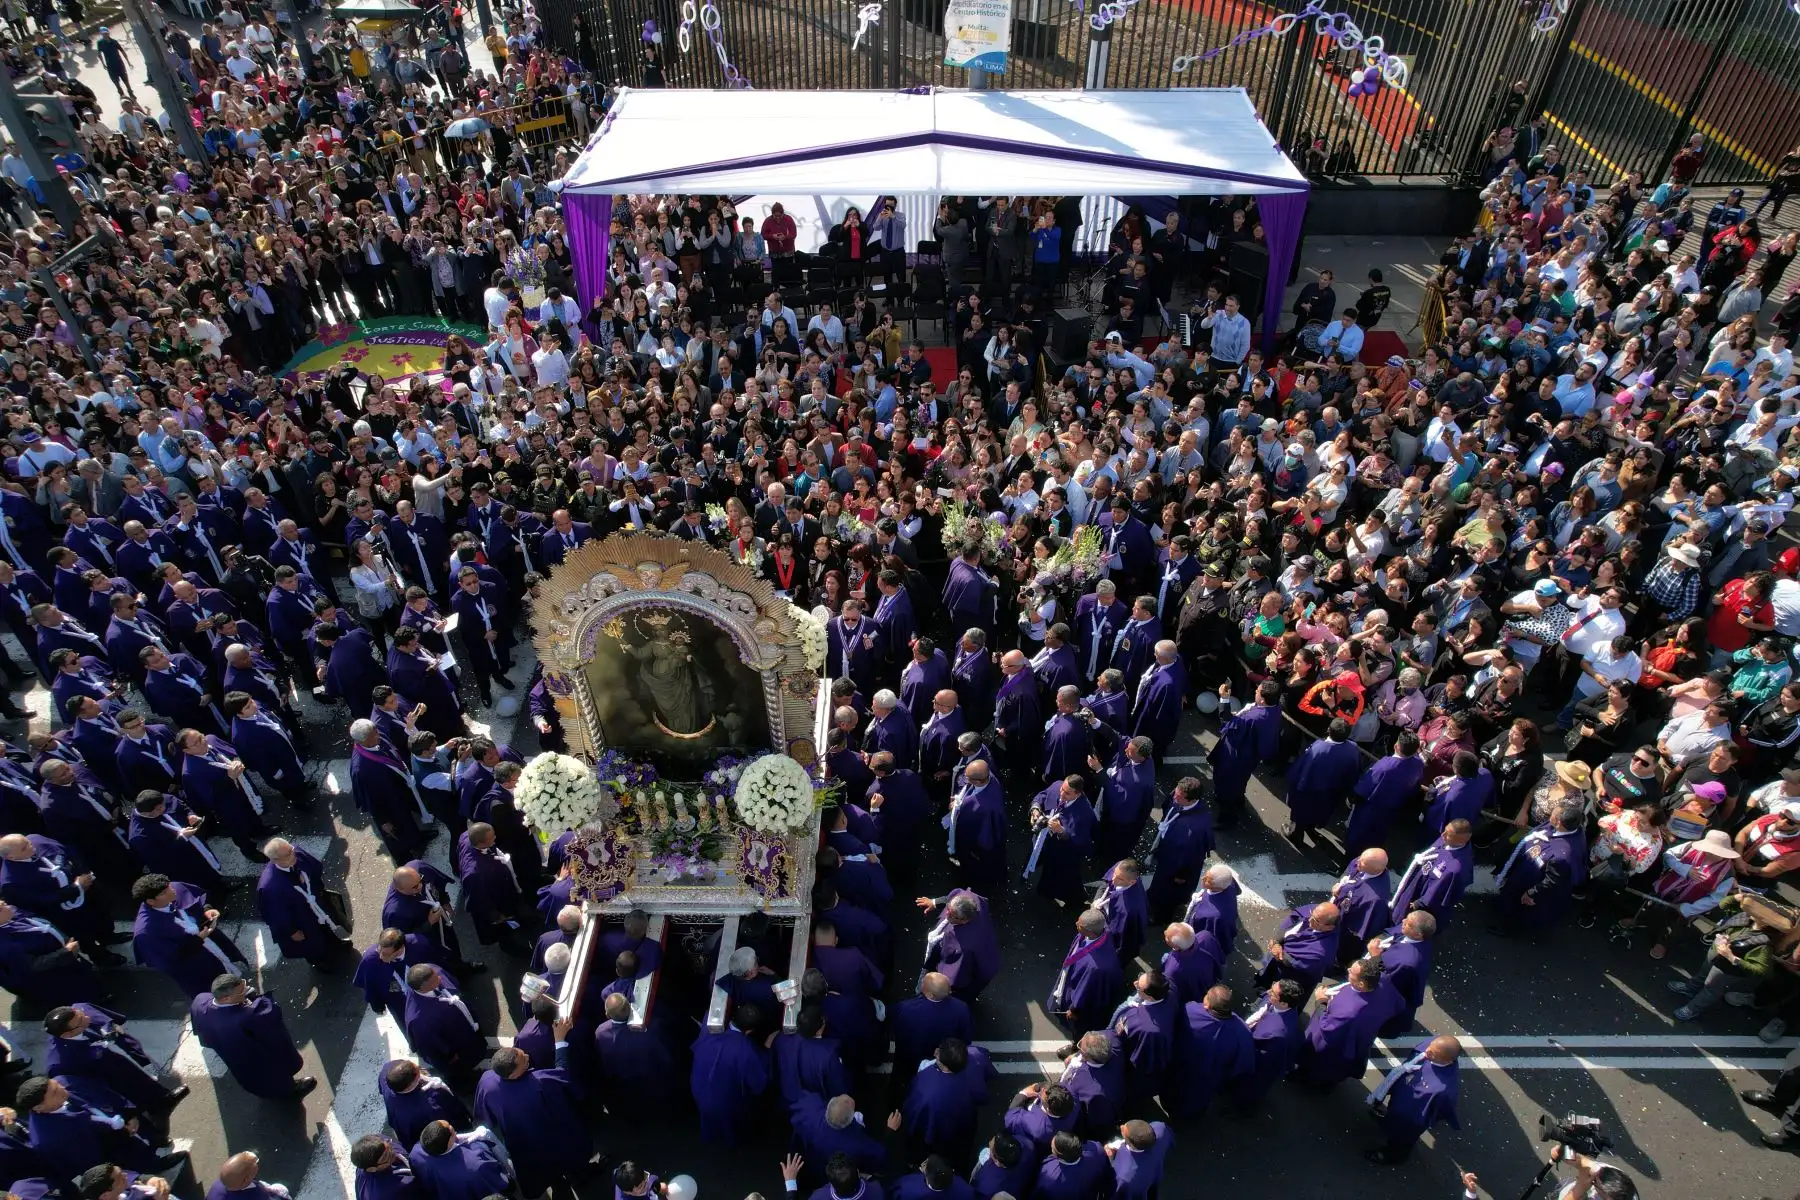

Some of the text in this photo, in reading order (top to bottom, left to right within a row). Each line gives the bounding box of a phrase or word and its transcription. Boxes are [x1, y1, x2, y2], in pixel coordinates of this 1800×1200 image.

[954, 8, 1006, 18] Centro Histórico
[986, 64, 1004, 72] LIMA
[367, 335, 426, 345] JUSTICIA
